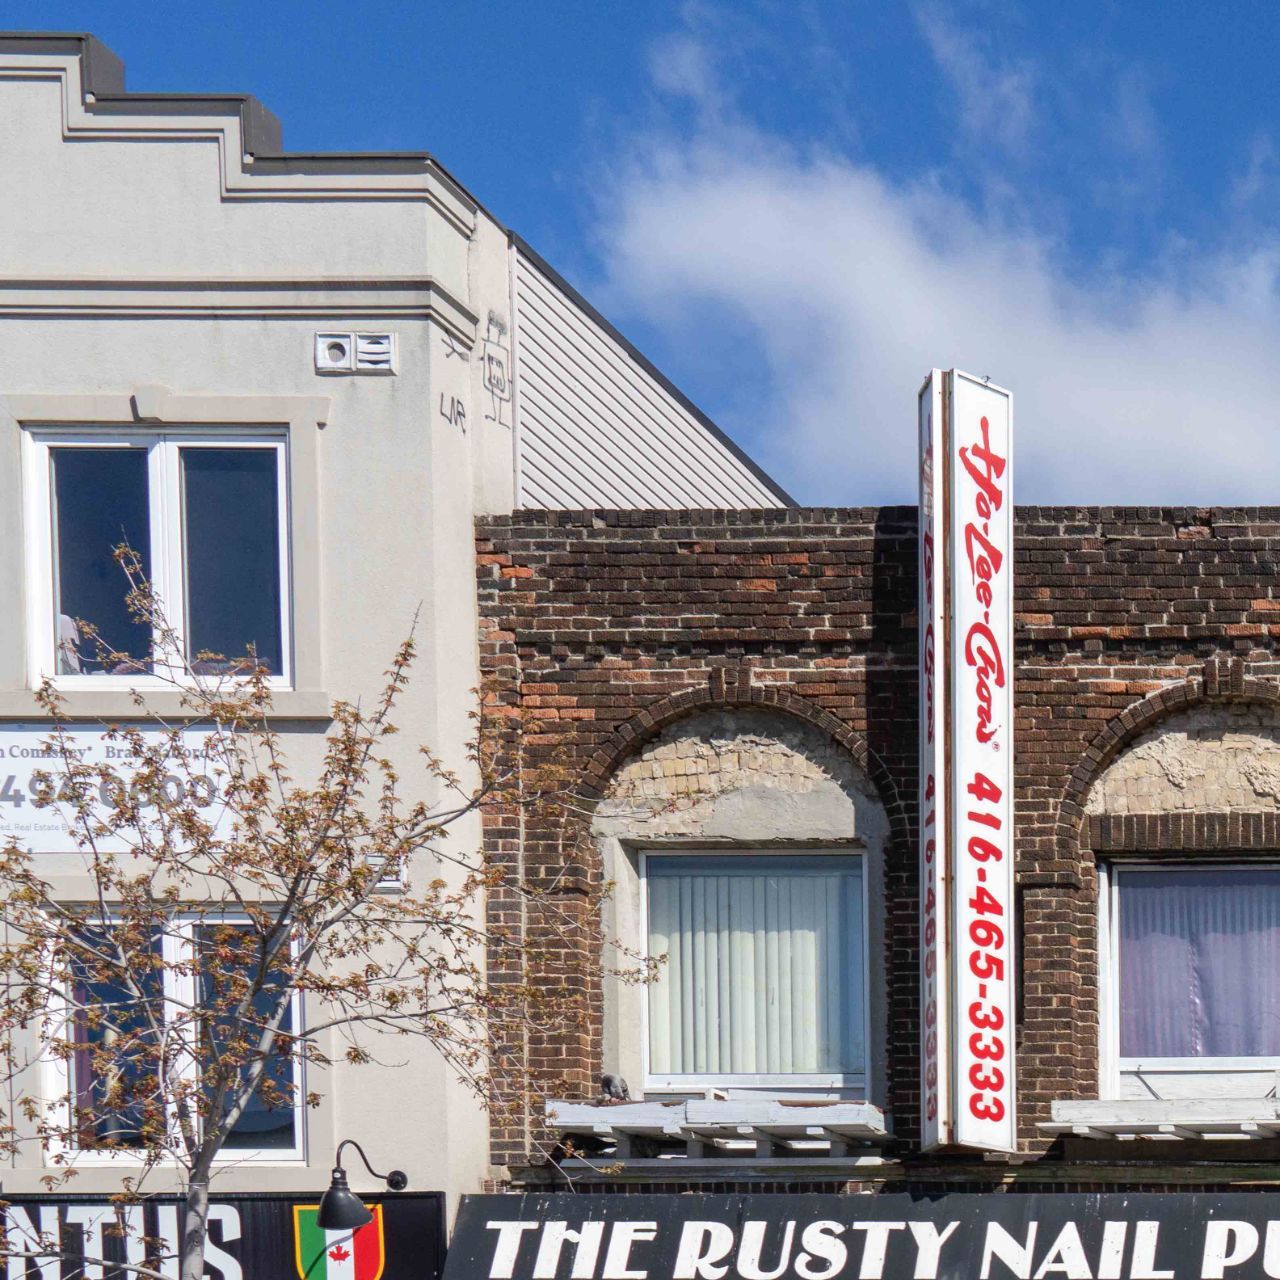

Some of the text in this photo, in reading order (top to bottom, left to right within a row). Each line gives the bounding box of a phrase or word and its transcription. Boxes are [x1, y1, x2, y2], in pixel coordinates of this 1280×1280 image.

[966, 772, 1005, 1123] 416-465-3333
[485, 1220, 658, 1280] THE
[672, 1220, 961, 1280] RUSTY
[979, 1220, 1175, 1280] NAIL
